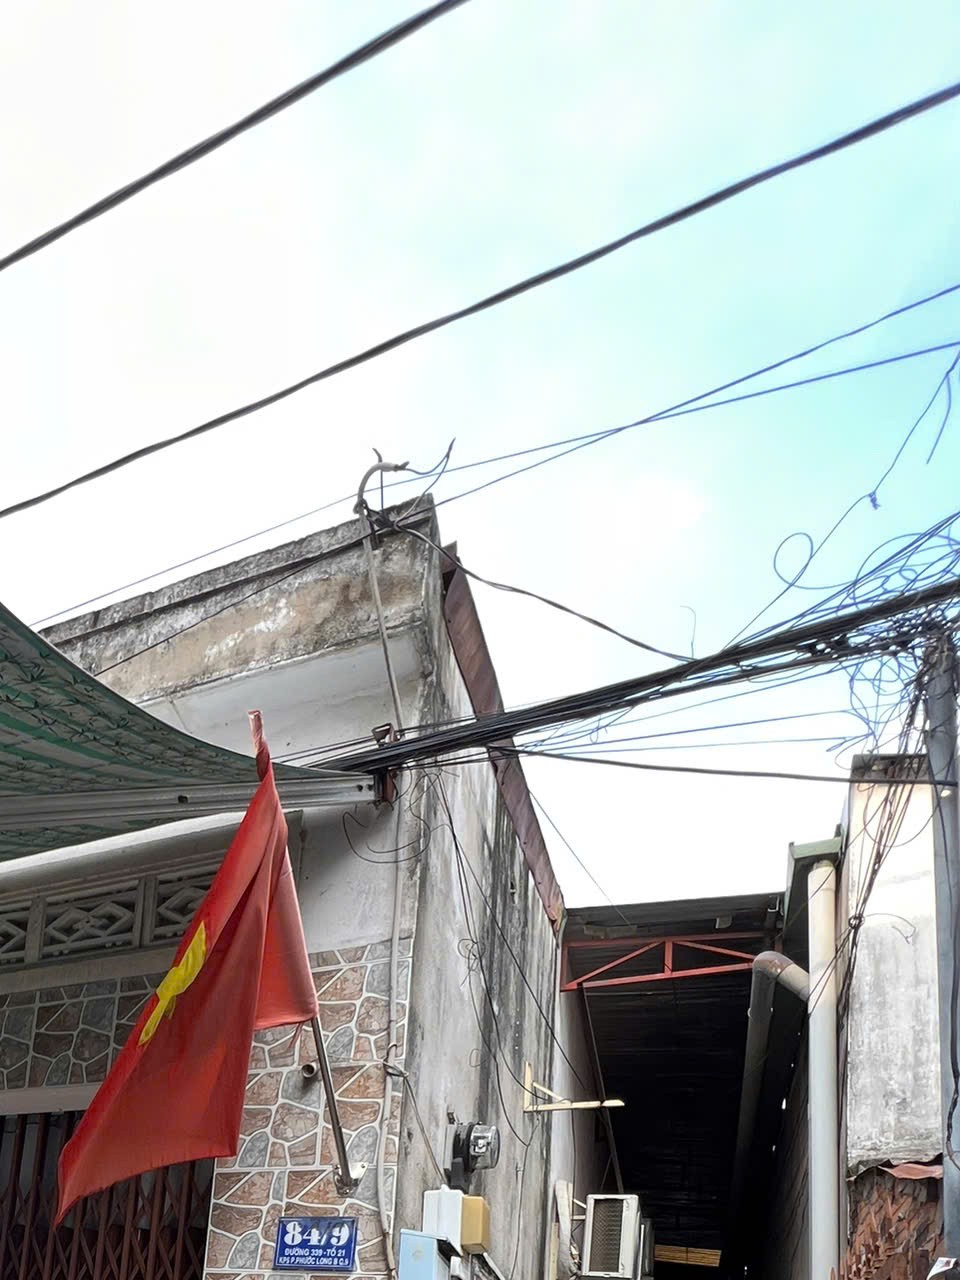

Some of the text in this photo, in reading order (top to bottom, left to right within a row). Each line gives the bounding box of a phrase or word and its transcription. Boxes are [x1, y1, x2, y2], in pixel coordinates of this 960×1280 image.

[284, 1221, 350, 1246] 84/9
[284, 1247, 310, 1256] ĐƯỜNG
[337, 1249, 346, 1257] 21
[316, 1257, 333, 1265] LONG
